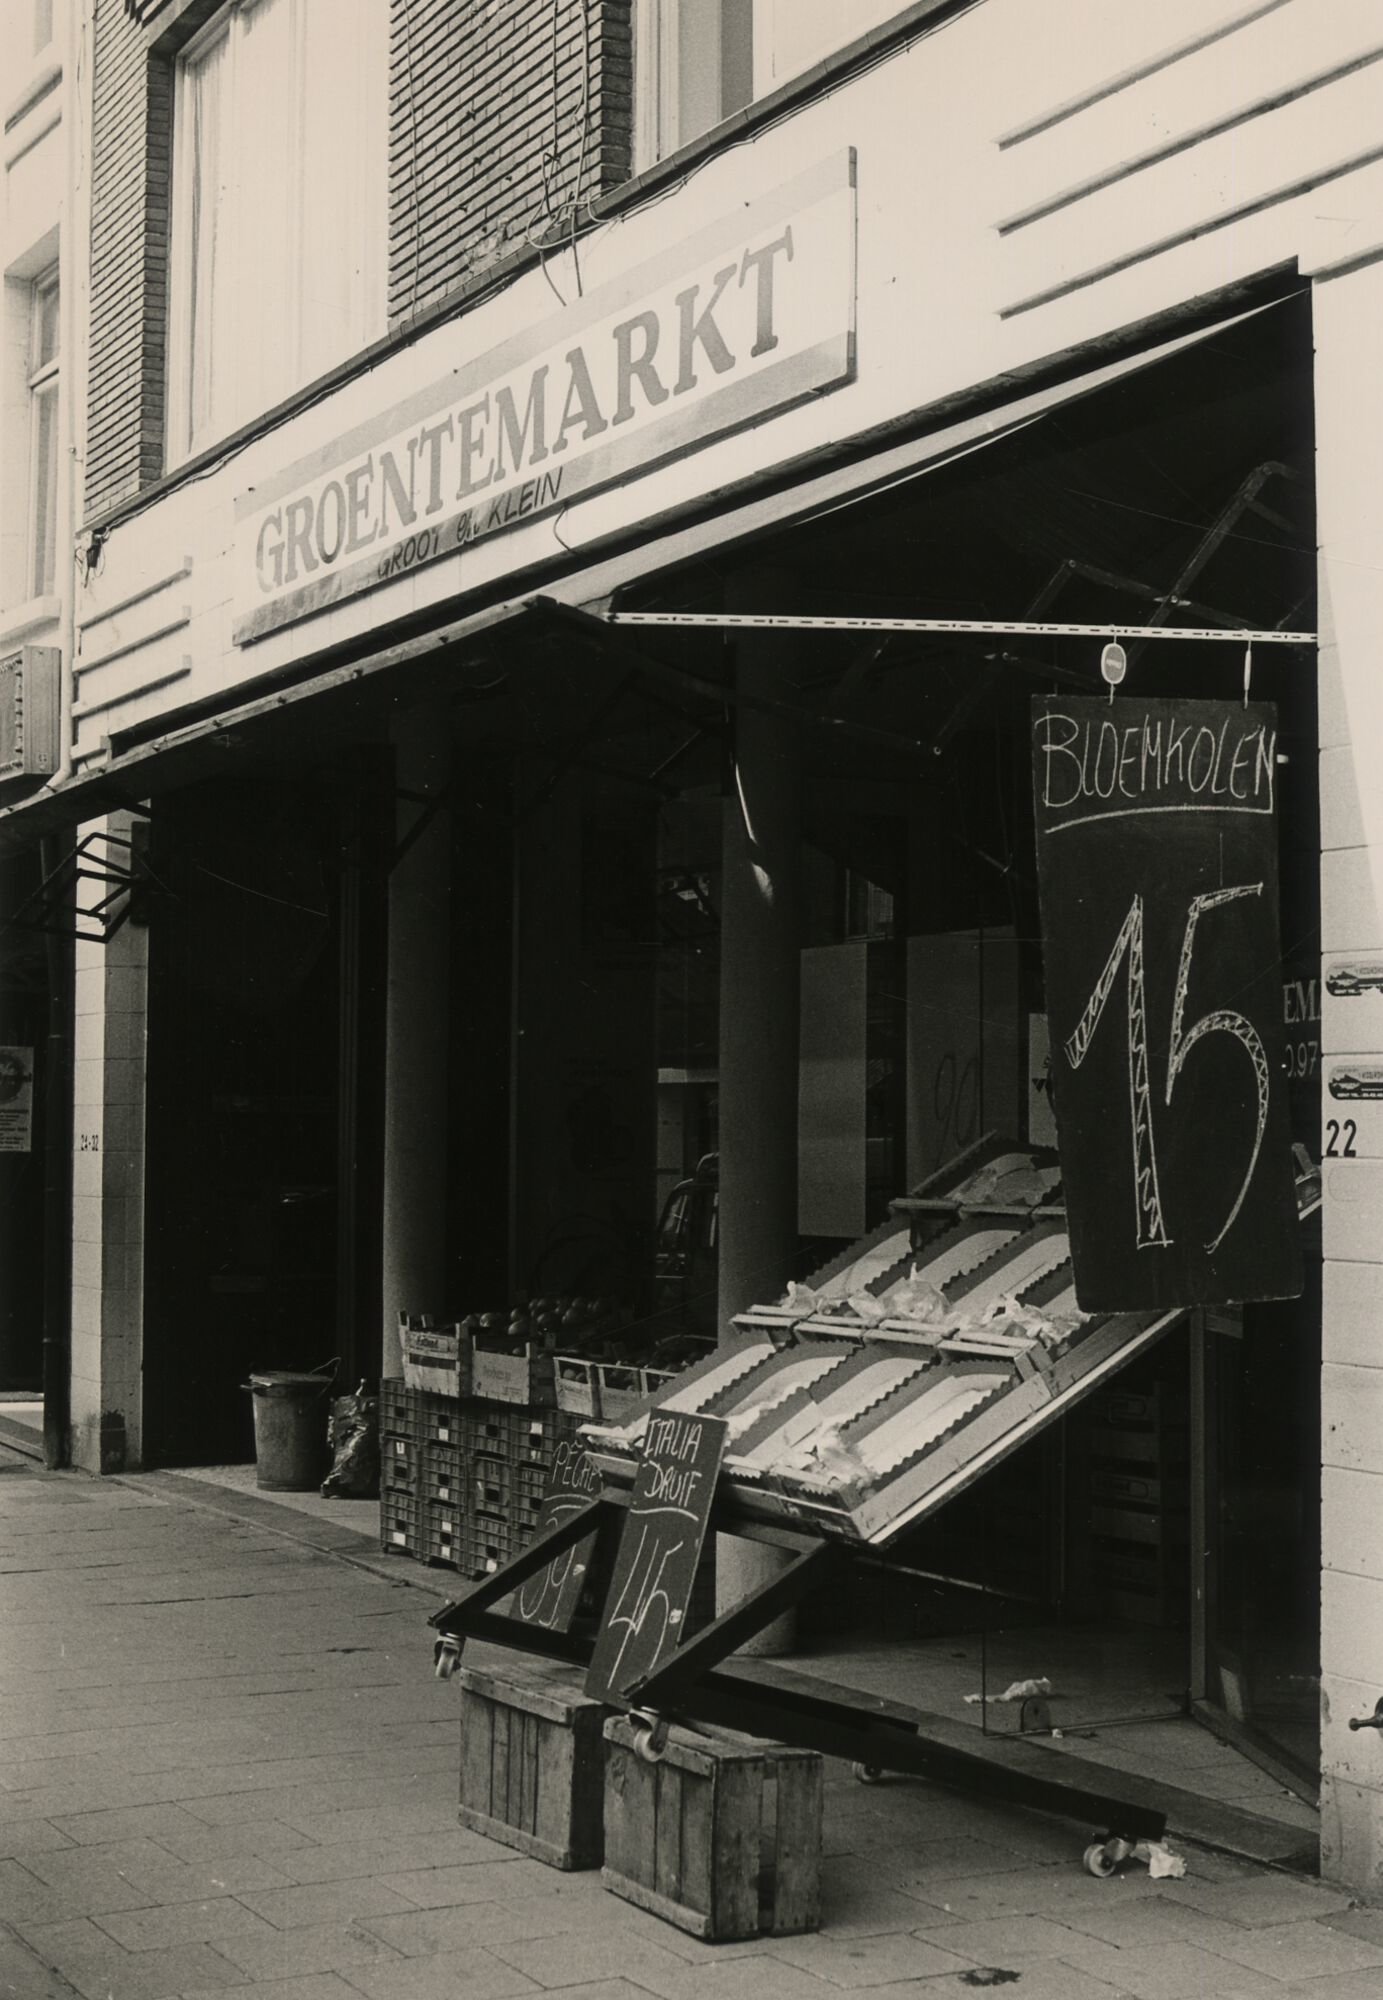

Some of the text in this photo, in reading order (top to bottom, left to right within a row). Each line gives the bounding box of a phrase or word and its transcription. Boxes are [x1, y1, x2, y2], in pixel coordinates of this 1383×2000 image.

[255, 224, 794, 594] GROENTEMARKT
[487, 466, 564, 528] KLEIN
[1034, 711, 1276, 810] BLOEMKOLEN
[1282, 979, 1321, 1025] EM
[1064, 882, 1269, 1255] 15
[1326, 1118, 1358, 1157] 22
[643, 1417, 703, 1464] ITALIA
[642, 1460, 703, 1508] DRUIF
[607, 1524, 684, 1689] 45
